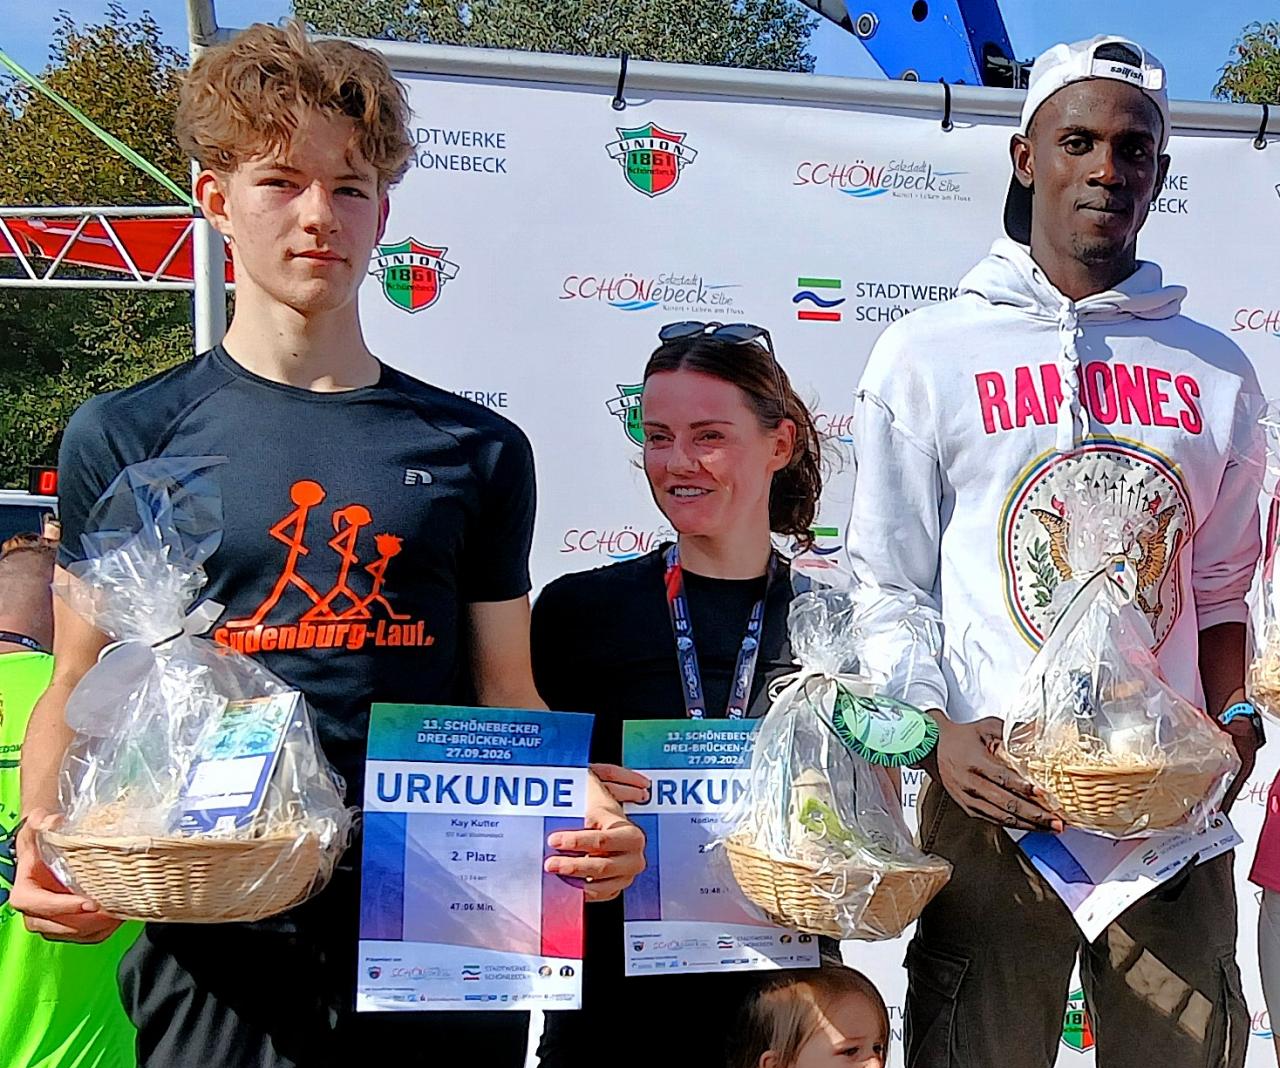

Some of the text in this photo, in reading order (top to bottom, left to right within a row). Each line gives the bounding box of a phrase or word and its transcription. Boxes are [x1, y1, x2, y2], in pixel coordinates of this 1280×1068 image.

[410, 127, 506, 149] DTWERKE
[619, 138, 685, 156] UNION
[410, 150, 507, 174] HÖNEBECK
[631, 152, 671, 166] 1861
[377, 254, 447, 271] UNION
[559, 273, 707, 304] SCHÖNebeck
[856, 282, 960, 302] STADTWERK
[423, 719, 540, 735] 13. SCHÖNEBECKER
[417, 732, 543, 748] DREI-BRÜCKEN-LAUF
[446, 748, 512, 760] 27.09.2026
[377, 772, 575, 808] URKUNDE
[466, 851, 497, 863] Platz
